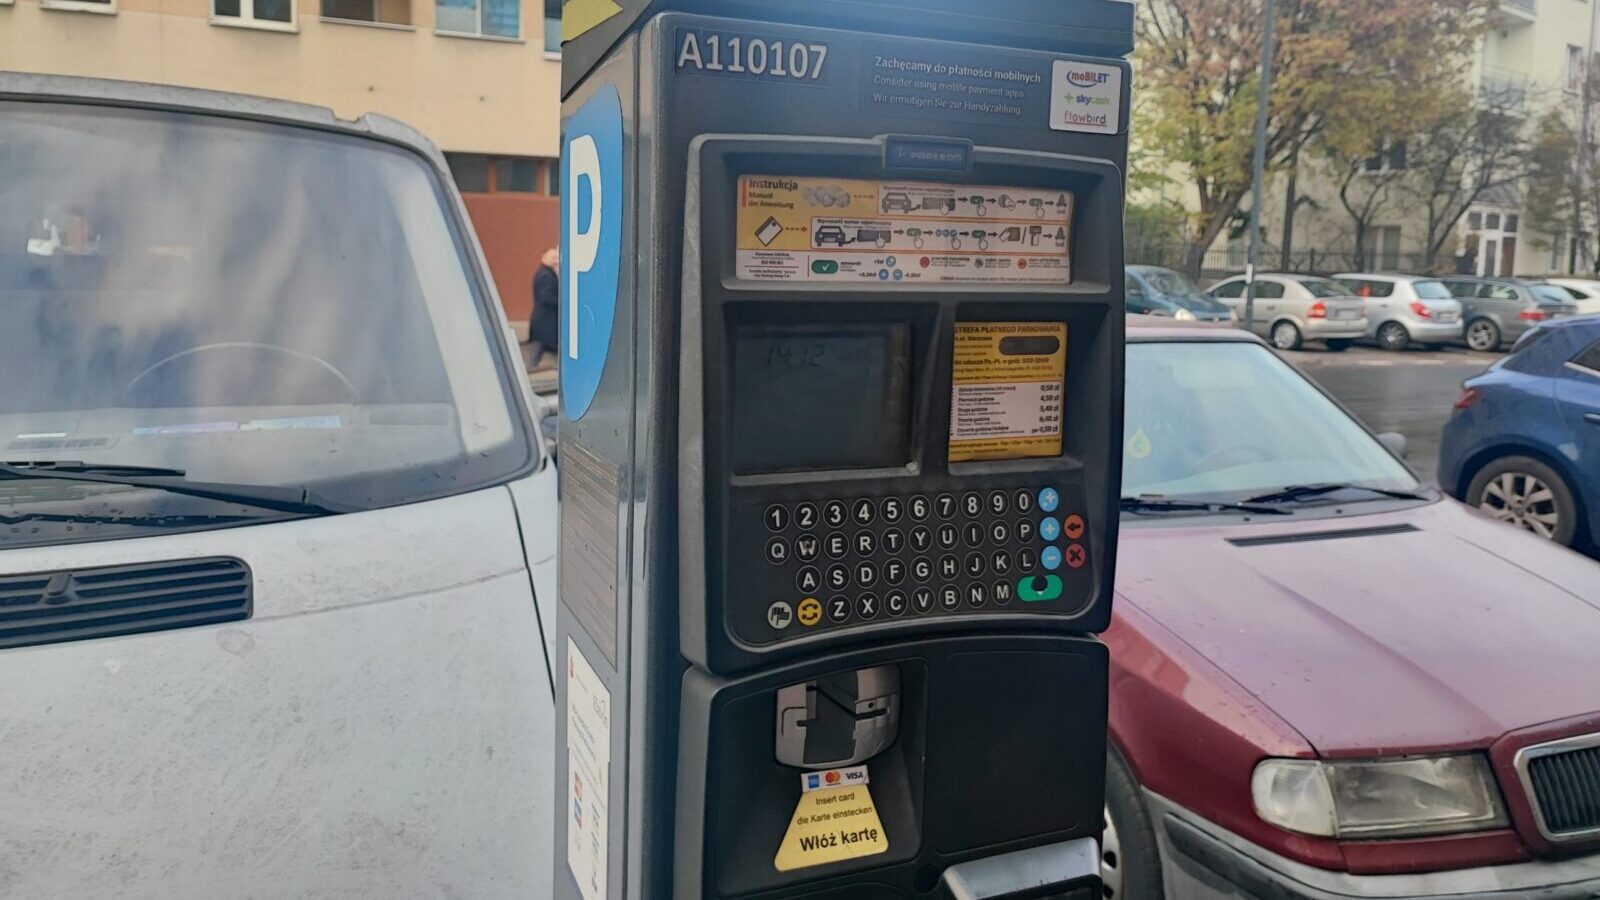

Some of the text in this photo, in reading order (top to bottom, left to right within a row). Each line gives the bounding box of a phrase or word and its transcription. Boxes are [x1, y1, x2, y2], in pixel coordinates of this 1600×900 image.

[678, 32, 827, 79] A110107
[874, 56, 1041, 84] Zachęcamy do płatności mobilnych
[874, 75, 1024, 98] Consider using mobile payment apps
[874, 93, 888, 102] Wir
[890, 95, 934, 108] ermutigen
[935, 99, 948, 108] Sie
[950, 102, 962, 110] zur
[749, 179, 798, 191] Instrukcja
[569, 134, 602, 360] P
[772, 493, 1028, 527] 1 2 3 4 5 6 7 8 9 0
[771, 524, 1030, 558] Q W E R T Y U I O P
[803, 554, 1031, 587] A S D F G H J K L
[834, 585, 1009, 616] Z X C V B N M
[816, 793, 855, 805] Insert card
[797, 807, 872, 825] die Karte einstecken
[800, 828, 877, 851] Włóż kartę
